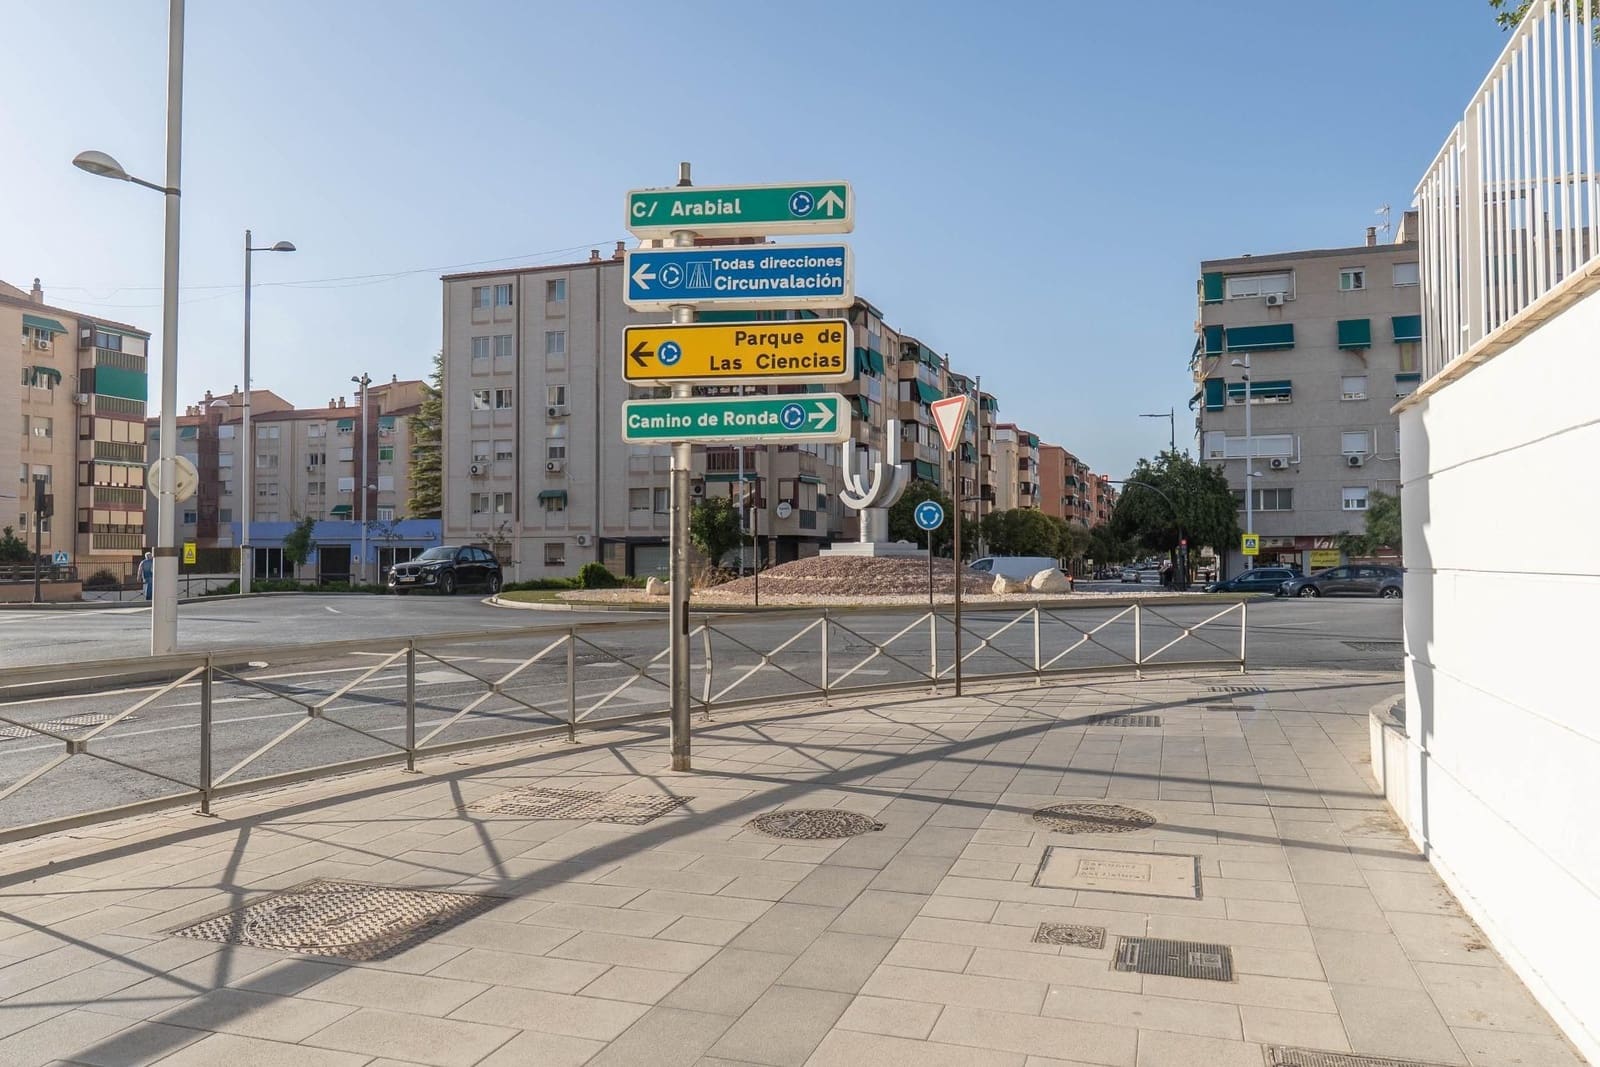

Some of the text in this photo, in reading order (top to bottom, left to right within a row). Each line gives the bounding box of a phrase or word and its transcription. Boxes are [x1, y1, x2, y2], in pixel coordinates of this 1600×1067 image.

[632, 198, 742, 218] C/ Arabial
[712, 255, 843, 270] Todas direcciones
[714, 273, 842, 290] Circunvalación
[735, 329, 842, 348] Parque de
[710, 352, 841, 370] Las Ciencias
[628, 411, 778, 429] Camino de Ronda
